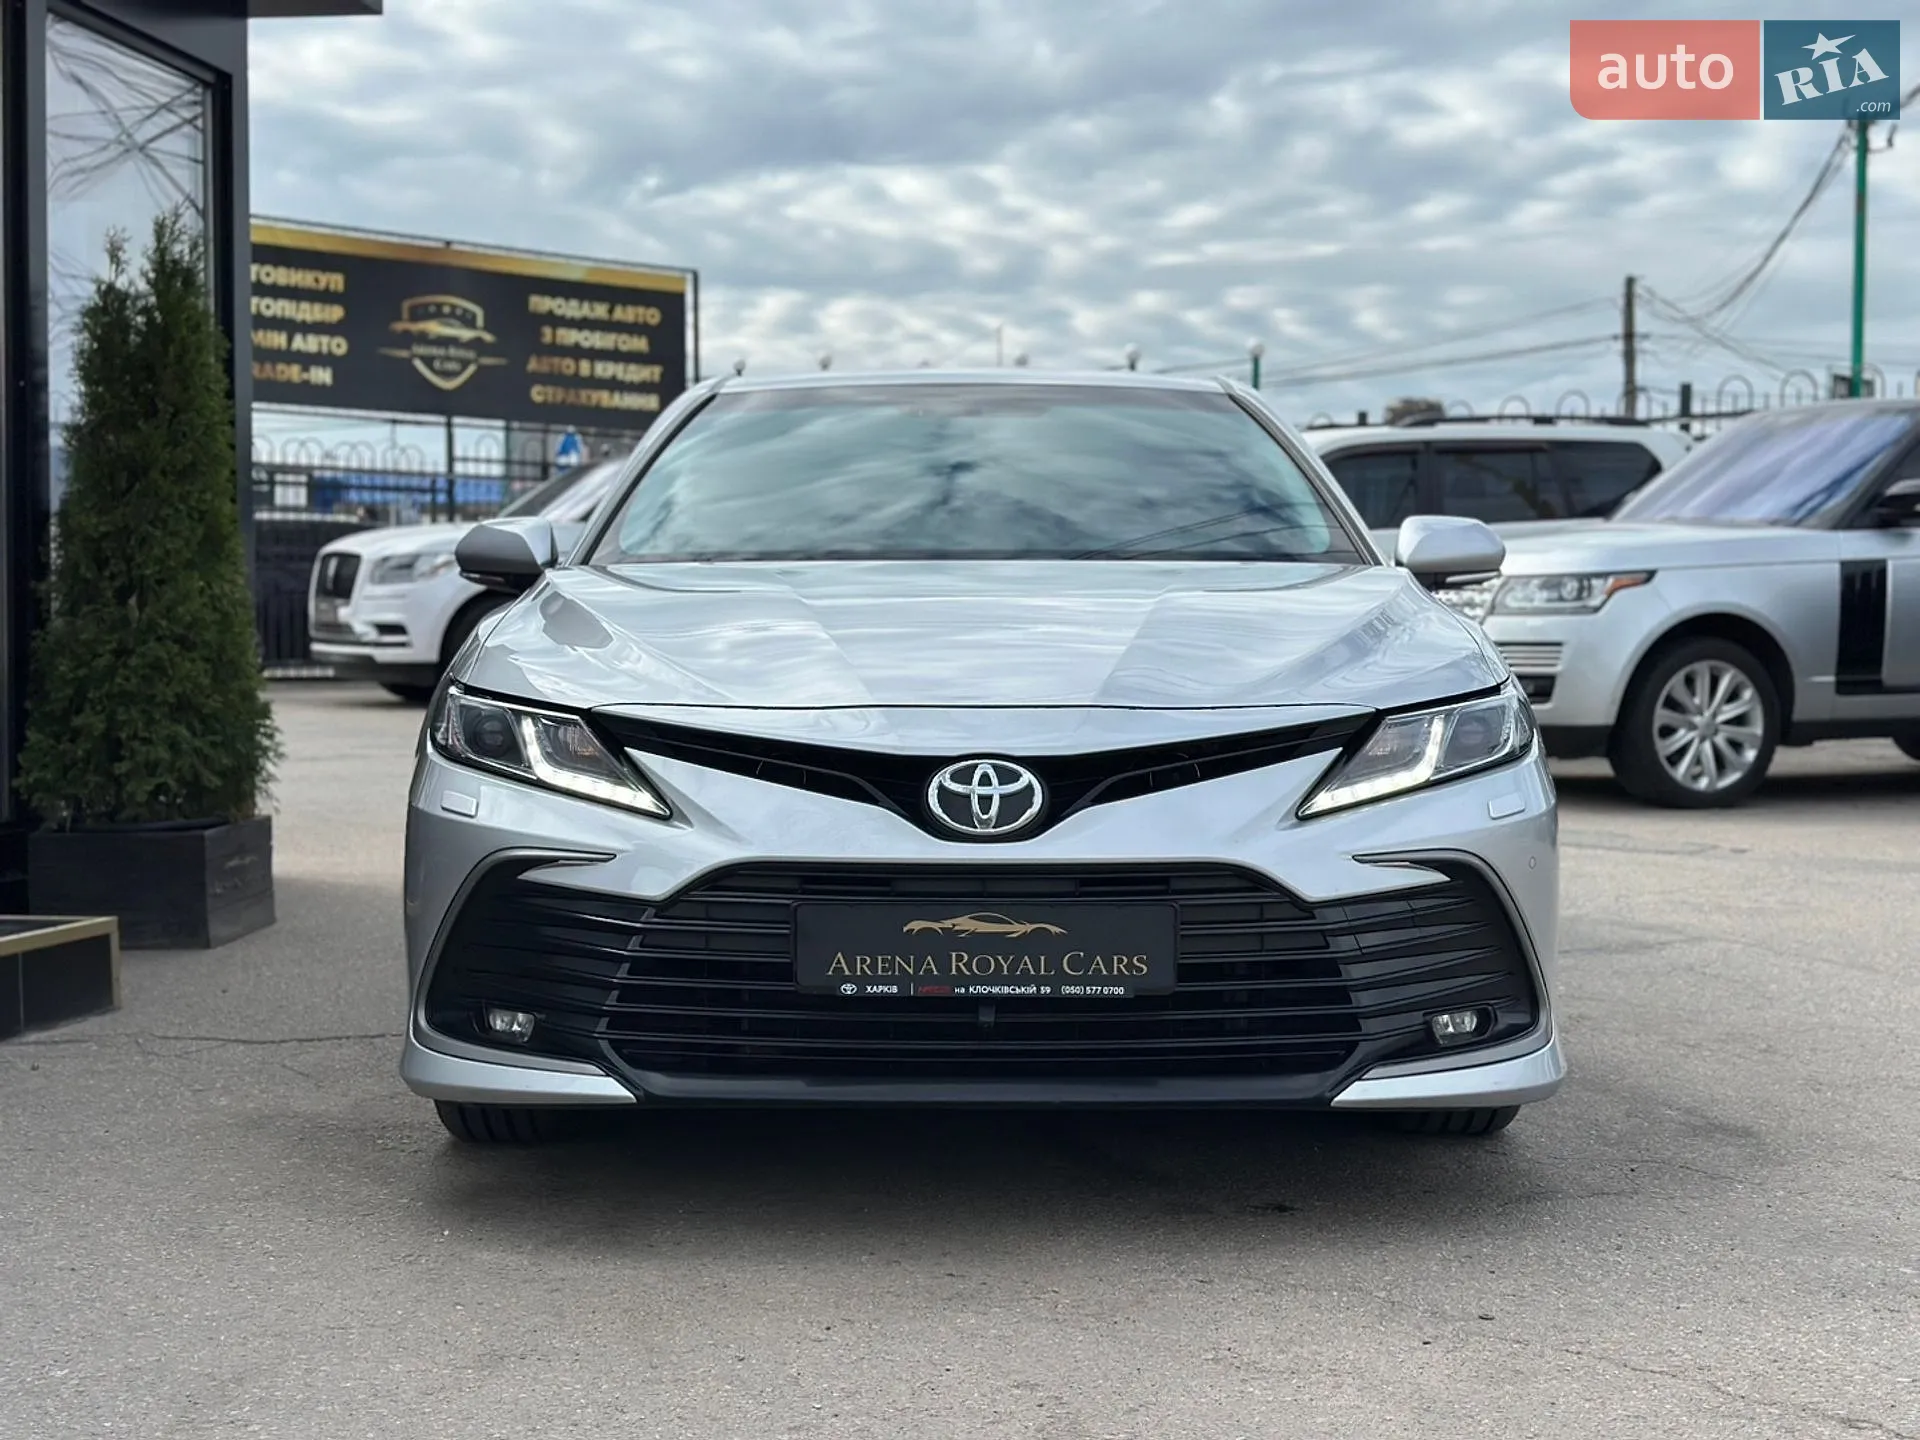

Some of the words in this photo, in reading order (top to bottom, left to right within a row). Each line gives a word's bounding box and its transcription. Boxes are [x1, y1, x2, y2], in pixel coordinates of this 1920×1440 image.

[528, 293, 610, 320] ПРОДАЖ
[611, 303, 661, 326] АВТО
[290, 331, 348, 356] АВТО
[555, 326, 650, 354] ПРОБІГОМ
[526, 353, 577, 376] АВТО
[593, 359, 663, 384] КРЕДИТ
[530, 383, 660, 411] СТРАХУВАННЯ
[826, 951, 939, 976] ARENA
[949, 951, 1055, 976] ROYAL
[1062, 951, 1148, 976] CARS
[865, 984, 899, 994] ХАРКІВ
[954, 985, 966, 995] на
[968, 983, 1037, 995] КЛОЧКІВСЬКІЙ
[1061, 984, 1084, 996] (050)
[1085, 986, 1101, 996] 577
[1102, 986, 1125, 996] 0700
